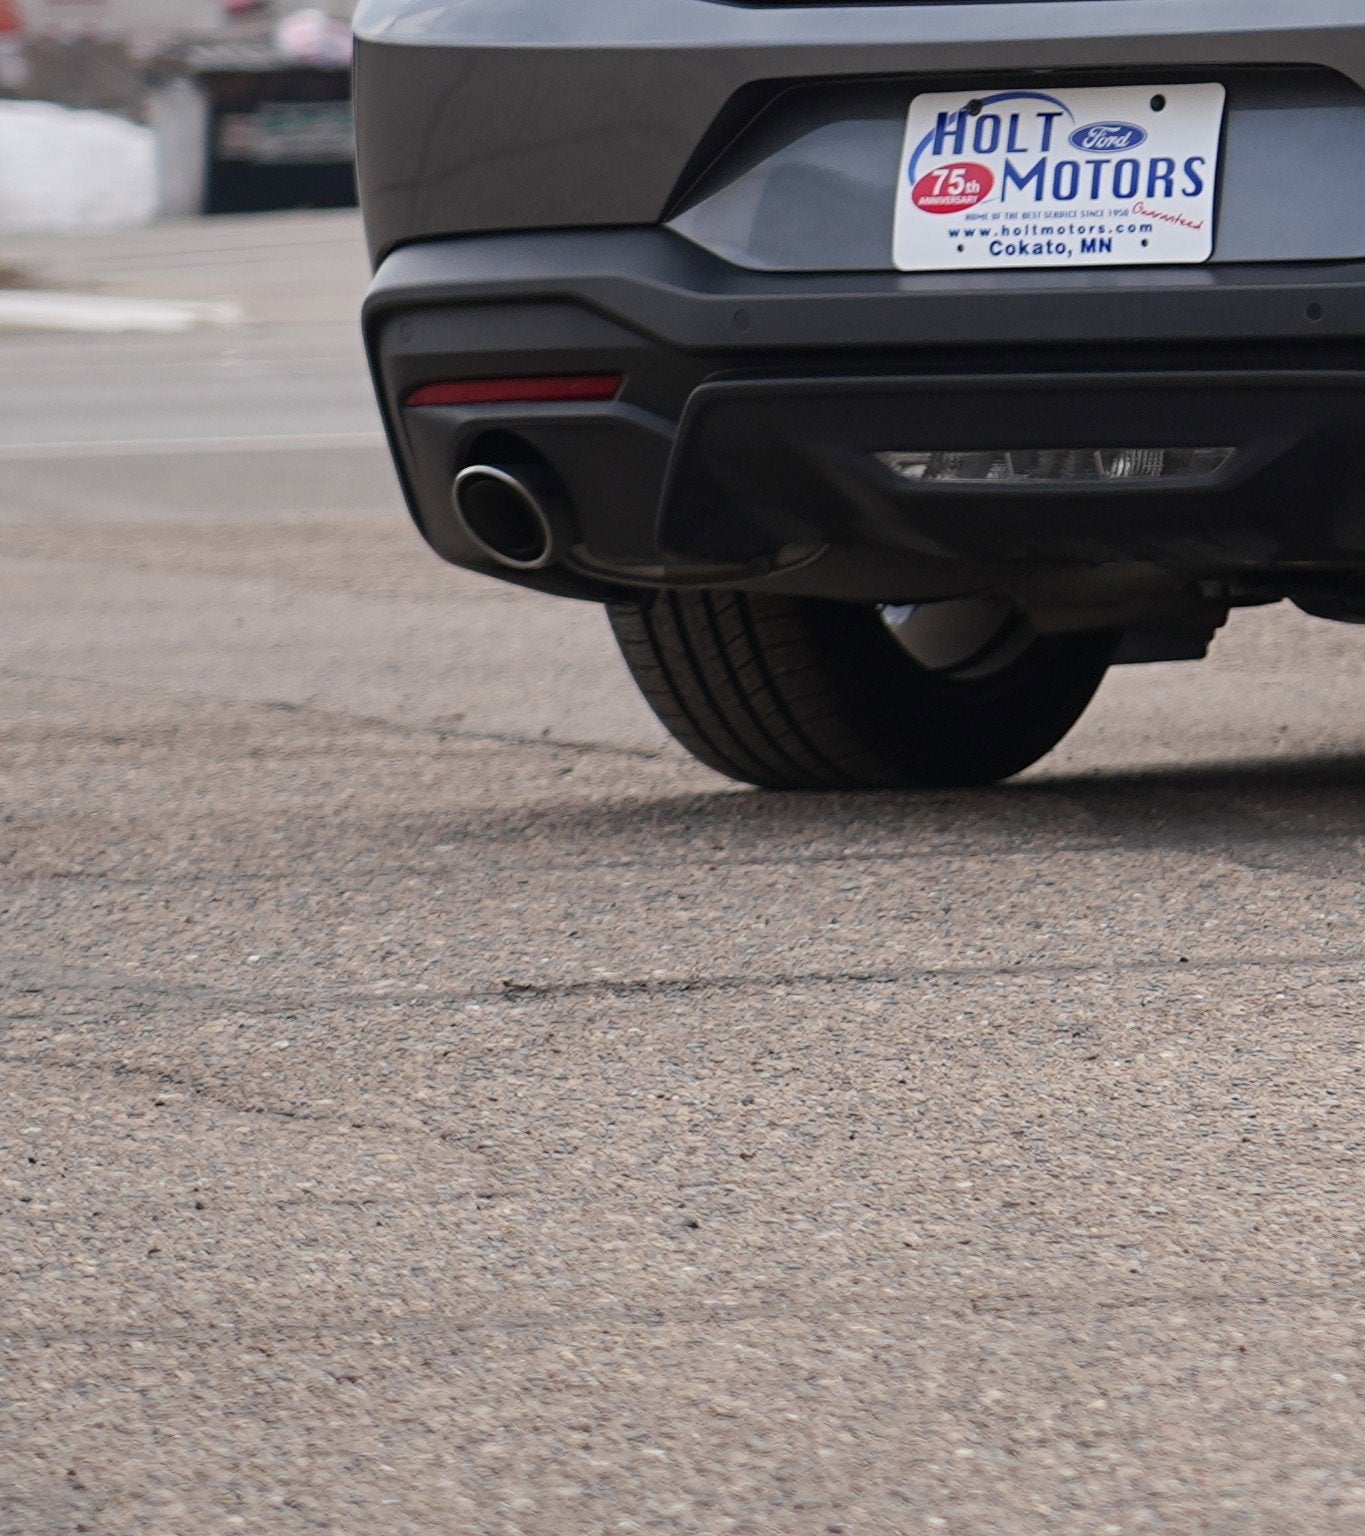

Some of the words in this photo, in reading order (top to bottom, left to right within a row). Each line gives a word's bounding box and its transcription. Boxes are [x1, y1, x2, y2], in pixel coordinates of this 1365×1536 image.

[932, 109, 1064, 155] HOLT
[1082, 126, 1133, 149] Ford
[931, 168, 981, 195] 75th
[1001, 156, 1206, 202] MOTORS
[918, 194, 979, 207] ANNIVERSARY
[1081, 209, 1104, 218] SINCE
[1132, 201, 1205, 231] Guaranteed
[948, 223, 1153, 238] www.holtmotors.com
[989, 239, 1073, 259] Cokato,
[1081, 237, 1113, 254] MN
